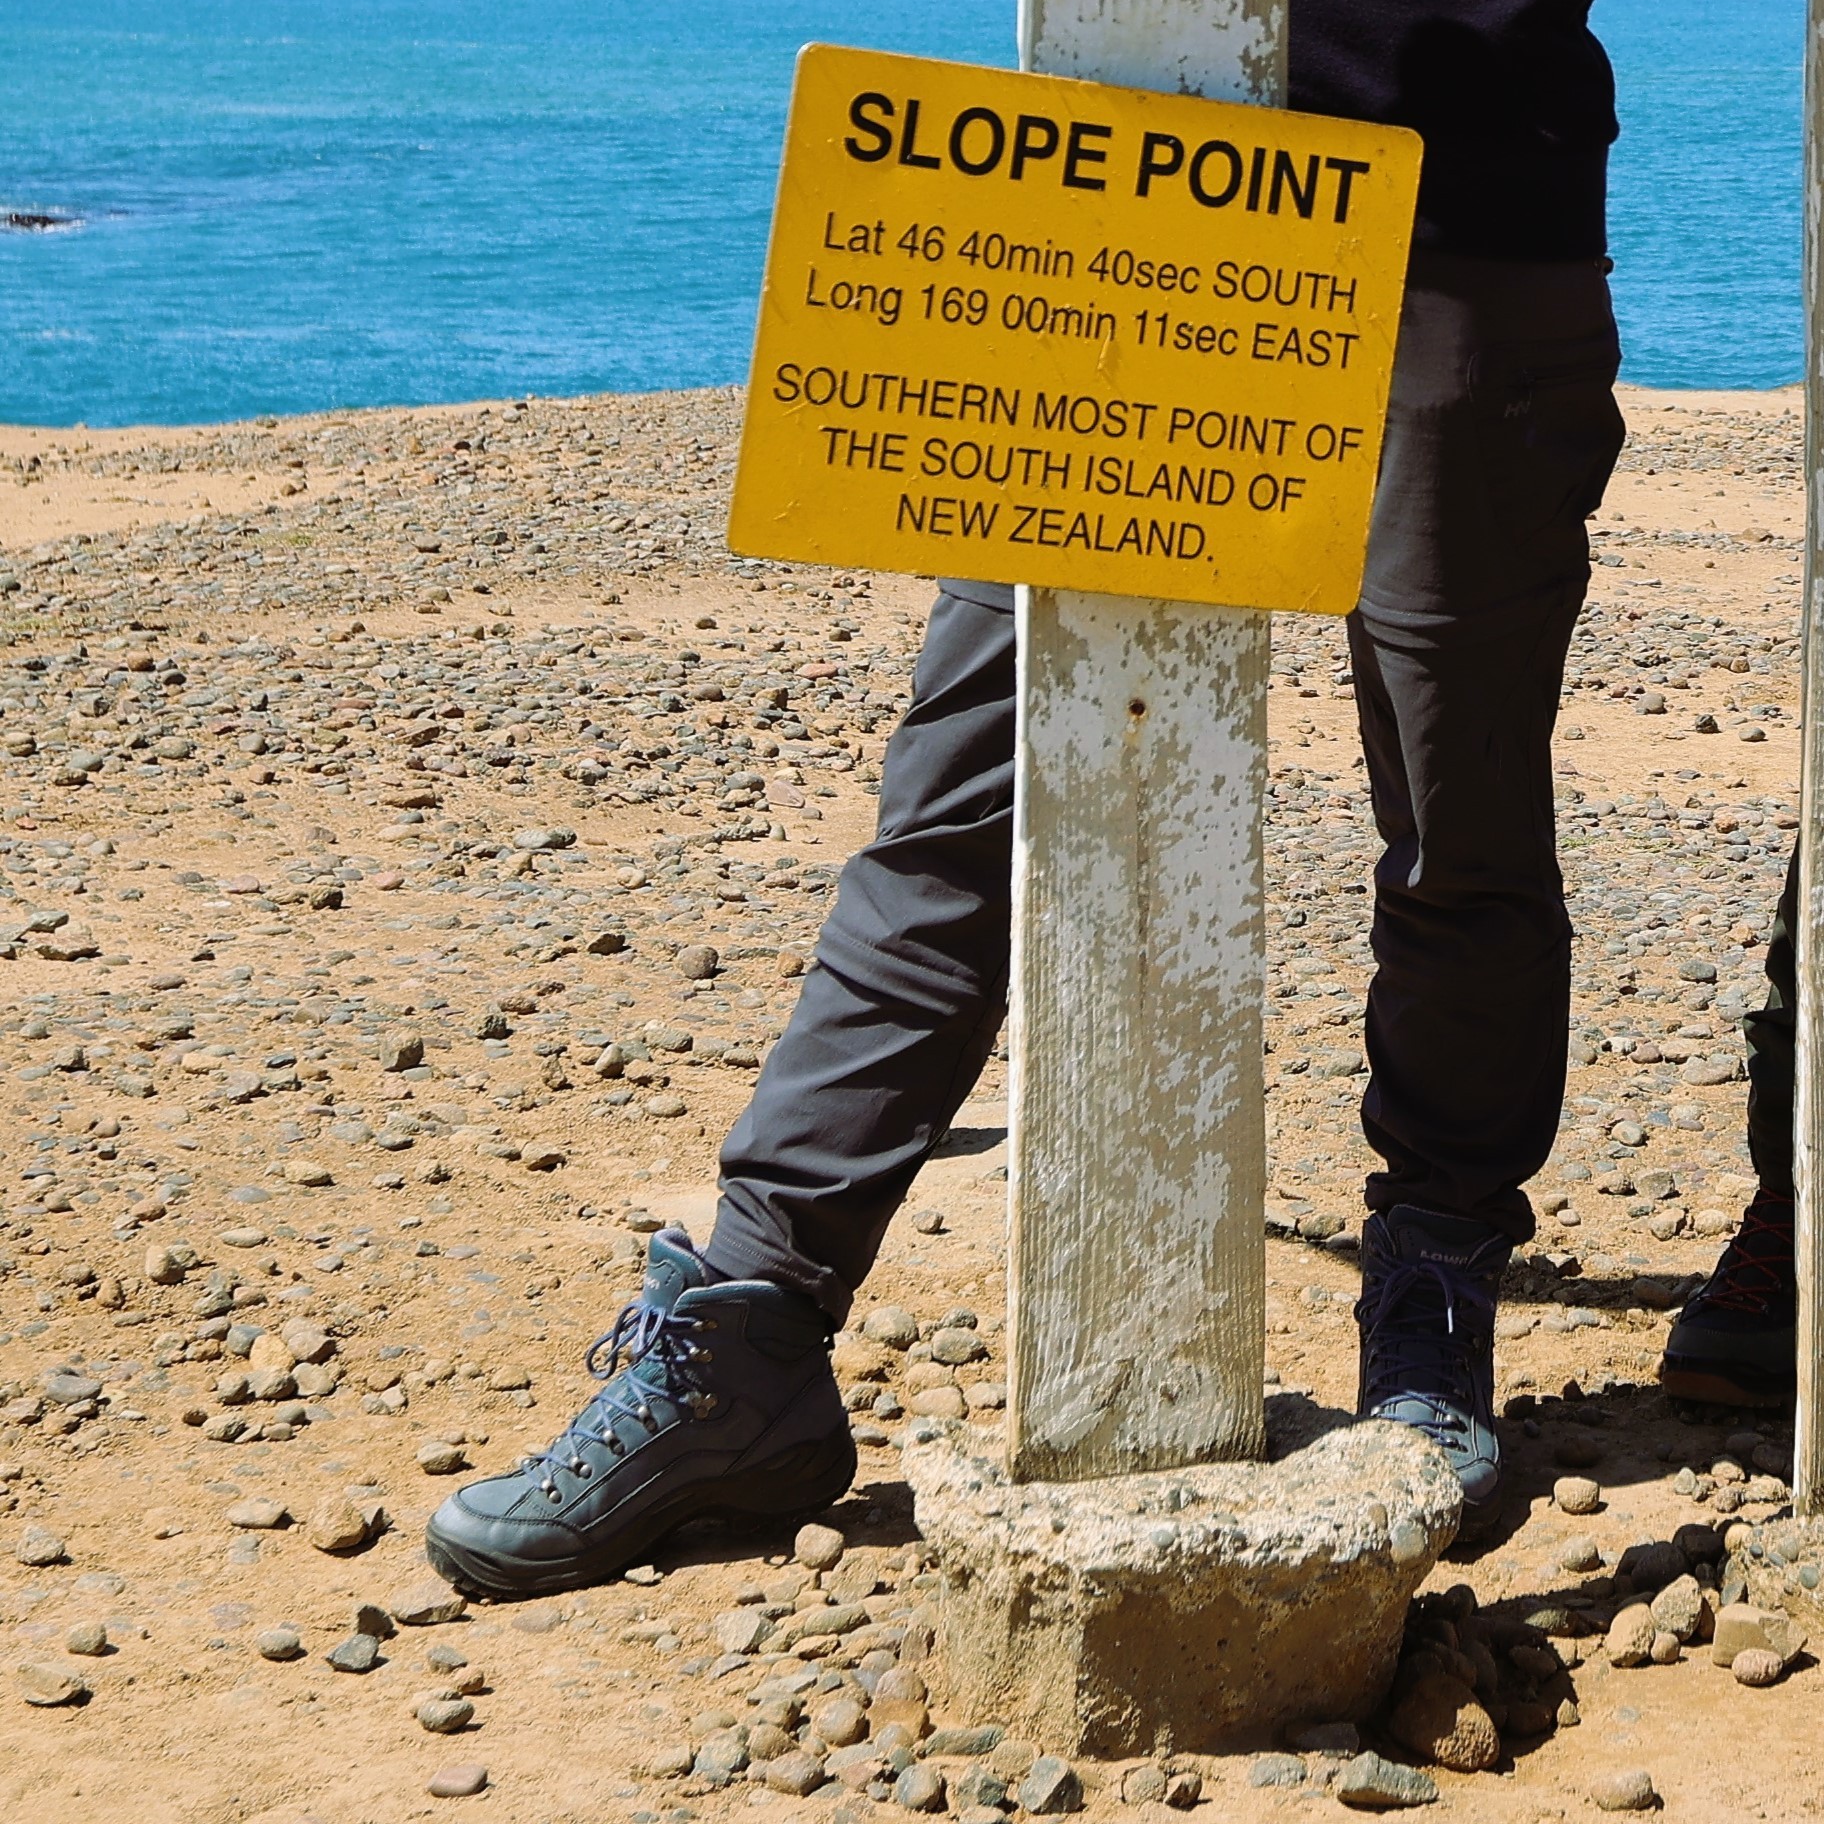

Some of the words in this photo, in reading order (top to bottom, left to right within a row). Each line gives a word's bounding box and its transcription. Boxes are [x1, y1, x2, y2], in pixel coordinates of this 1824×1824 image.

[845, 92, 1112, 191] SLOPE
[1136, 132, 1370, 223] POINT
[825, 212, 885, 255] Lat
[898, 224, 945, 261] 46
[958, 231, 1073, 277] 40min
[1088, 248, 1200, 293] 40sec
[1213, 262, 1356, 313] SOUTH
[807, 270, 902, 325] Long
[923, 284, 988, 325] 169
[1002, 294, 1115, 340] 00min
[1136, 311, 1238, 355] 11sec
[1252, 323, 1360, 368] EAST
[774, 364, 1019, 425] SOUTHERN
[1034, 393, 1157, 439] MOST
[1169, 408, 1296, 455] POINT
[1307, 424, 1363, 461] OF
[821, 427, 907, 472] THE
[921, 438, 1071, 489] SOUTH
[1085, 456, 1234, 505] ISLAND
[1249, 473, 1306, 511] OF
[897, 494, 999, 538] NEW
[1009, 506, 1213, 561] ZEALAND.
